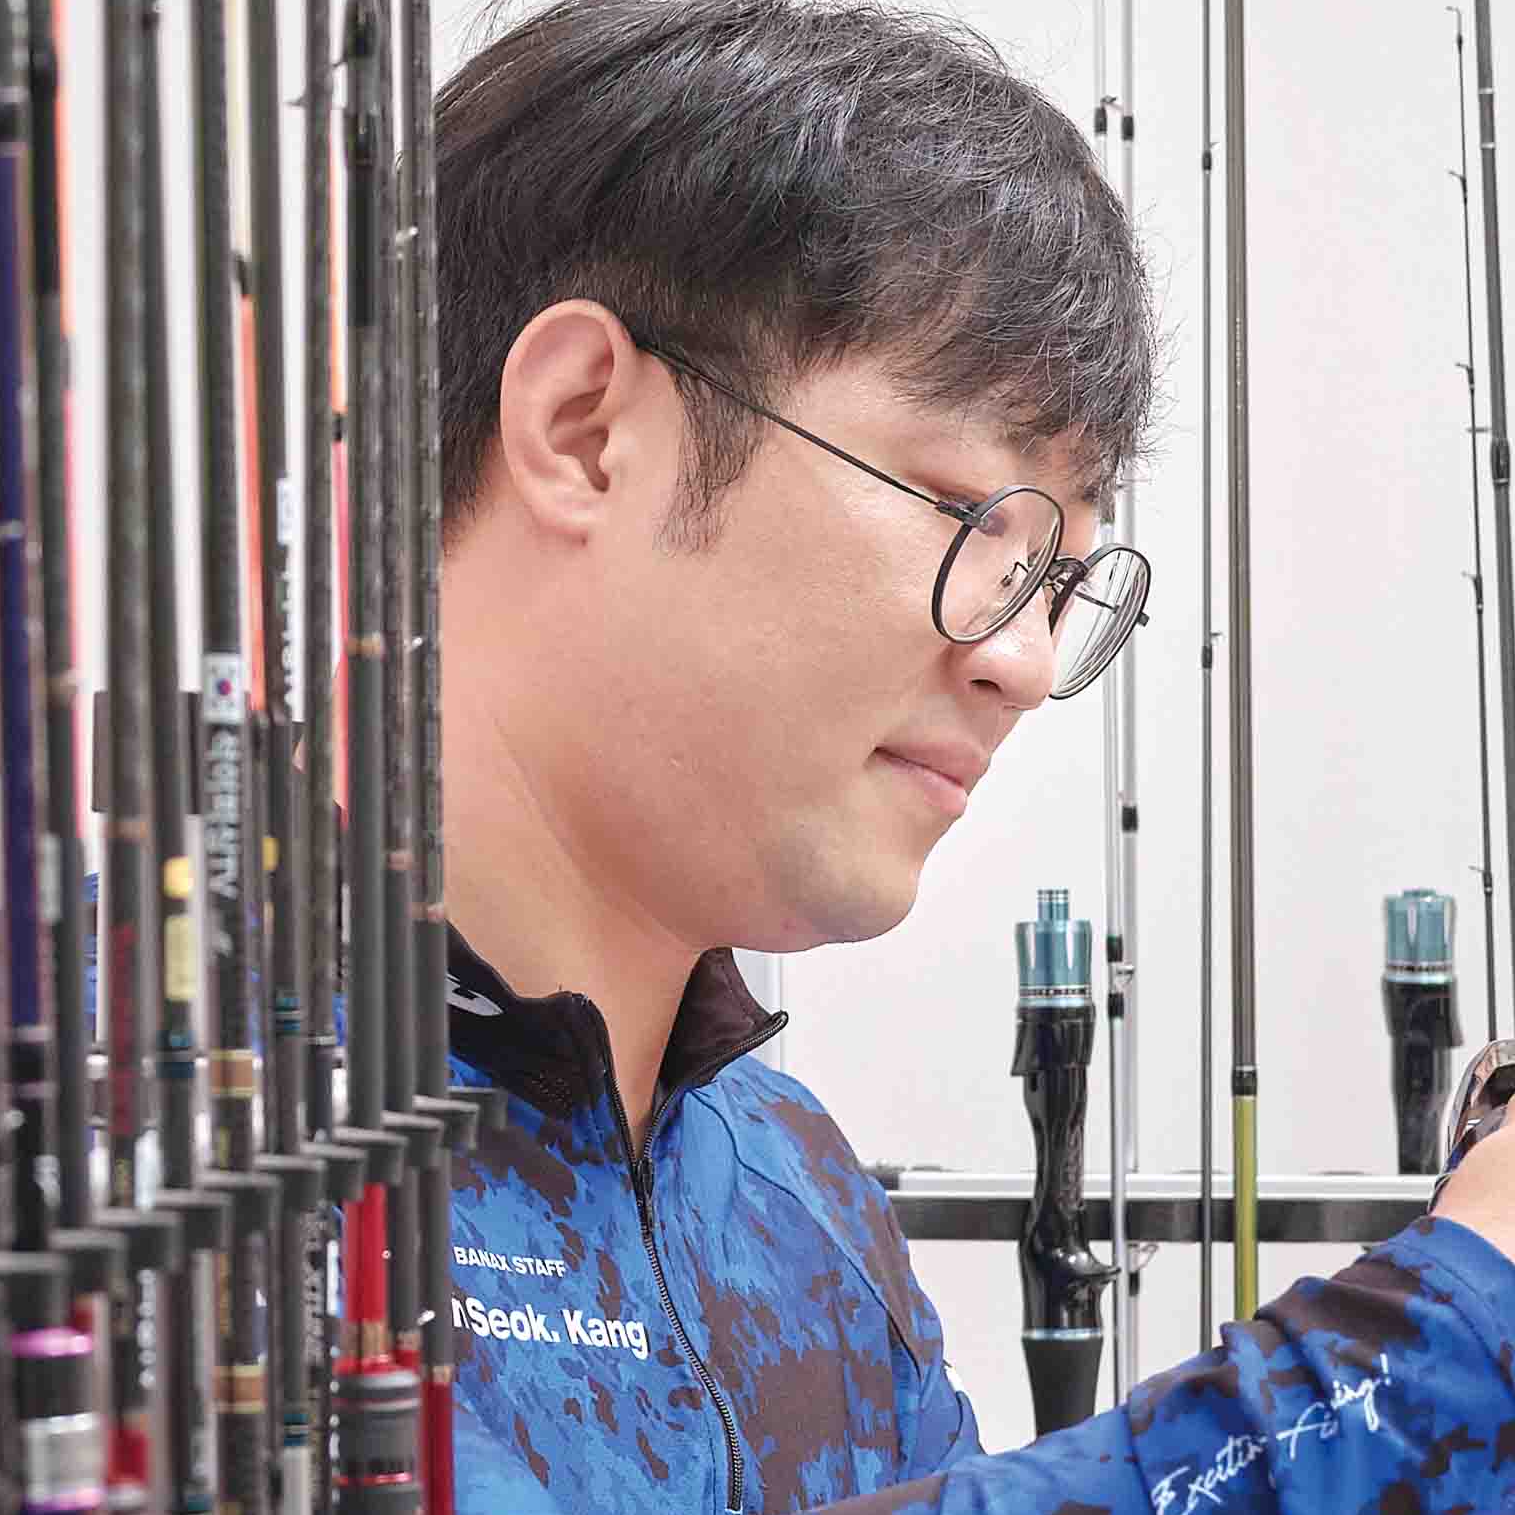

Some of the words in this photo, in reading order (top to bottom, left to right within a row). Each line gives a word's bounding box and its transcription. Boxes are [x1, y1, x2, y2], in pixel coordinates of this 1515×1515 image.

[453, 1245, 512, 1273] BANAX
[513, 1254, 567, 1278] STAFF
[562, 1308, 651, 1361] Kang
